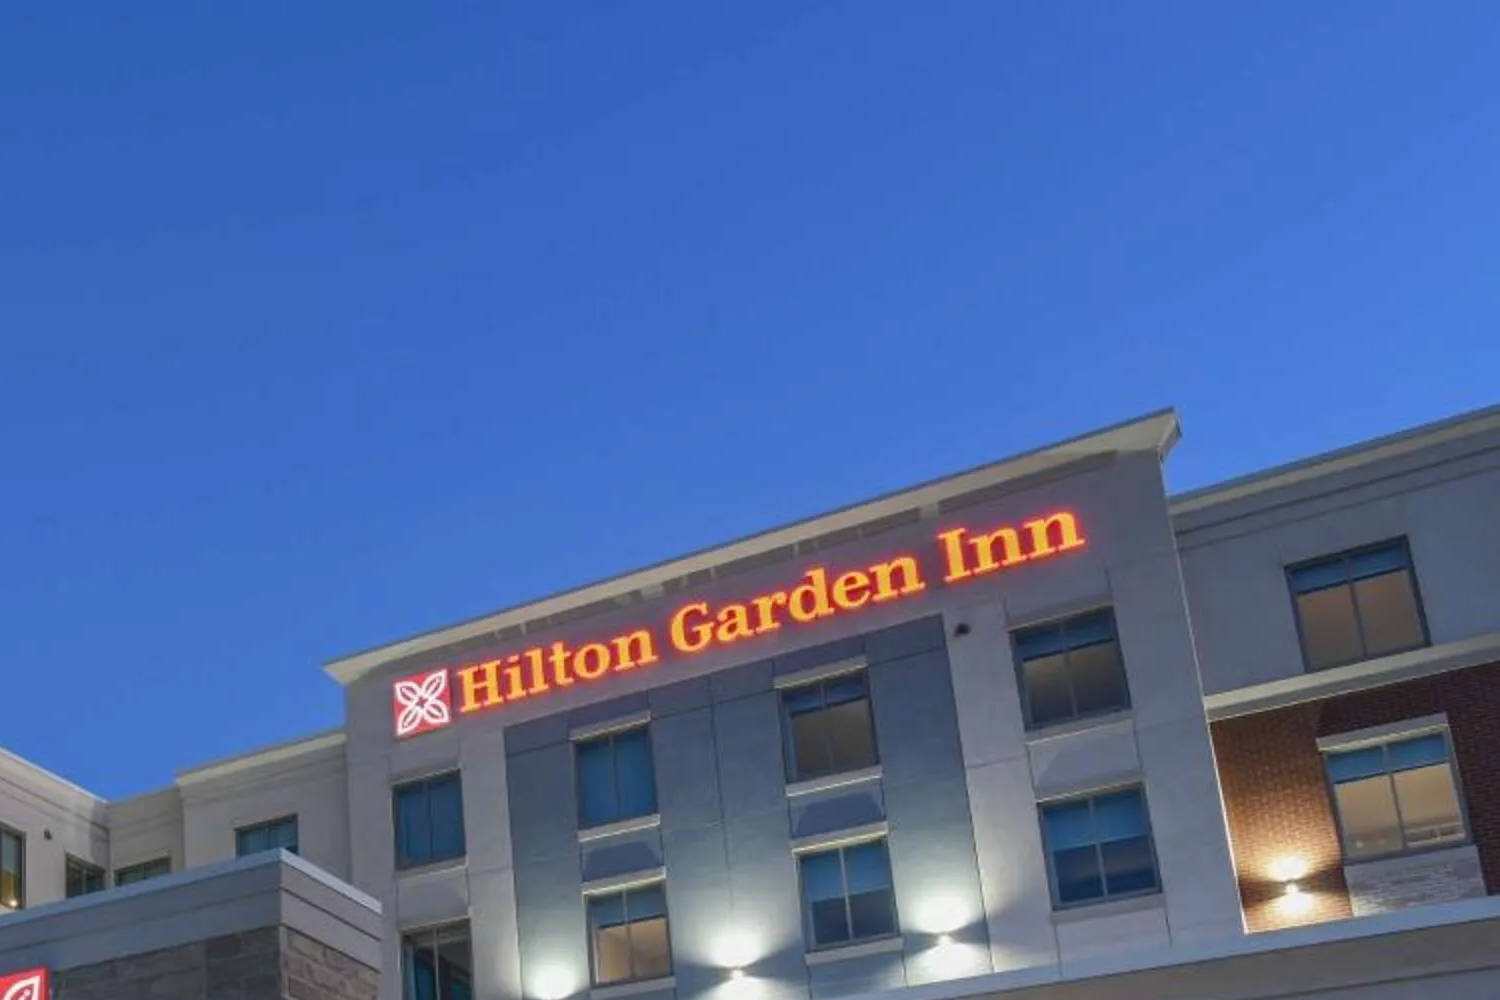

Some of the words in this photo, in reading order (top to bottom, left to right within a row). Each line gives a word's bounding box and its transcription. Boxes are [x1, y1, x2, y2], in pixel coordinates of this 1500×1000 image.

[457, 629, 657, 713] Hilton
[670, 555, 925, 652] Garden
[938, 510, 1085, 584] Inn
